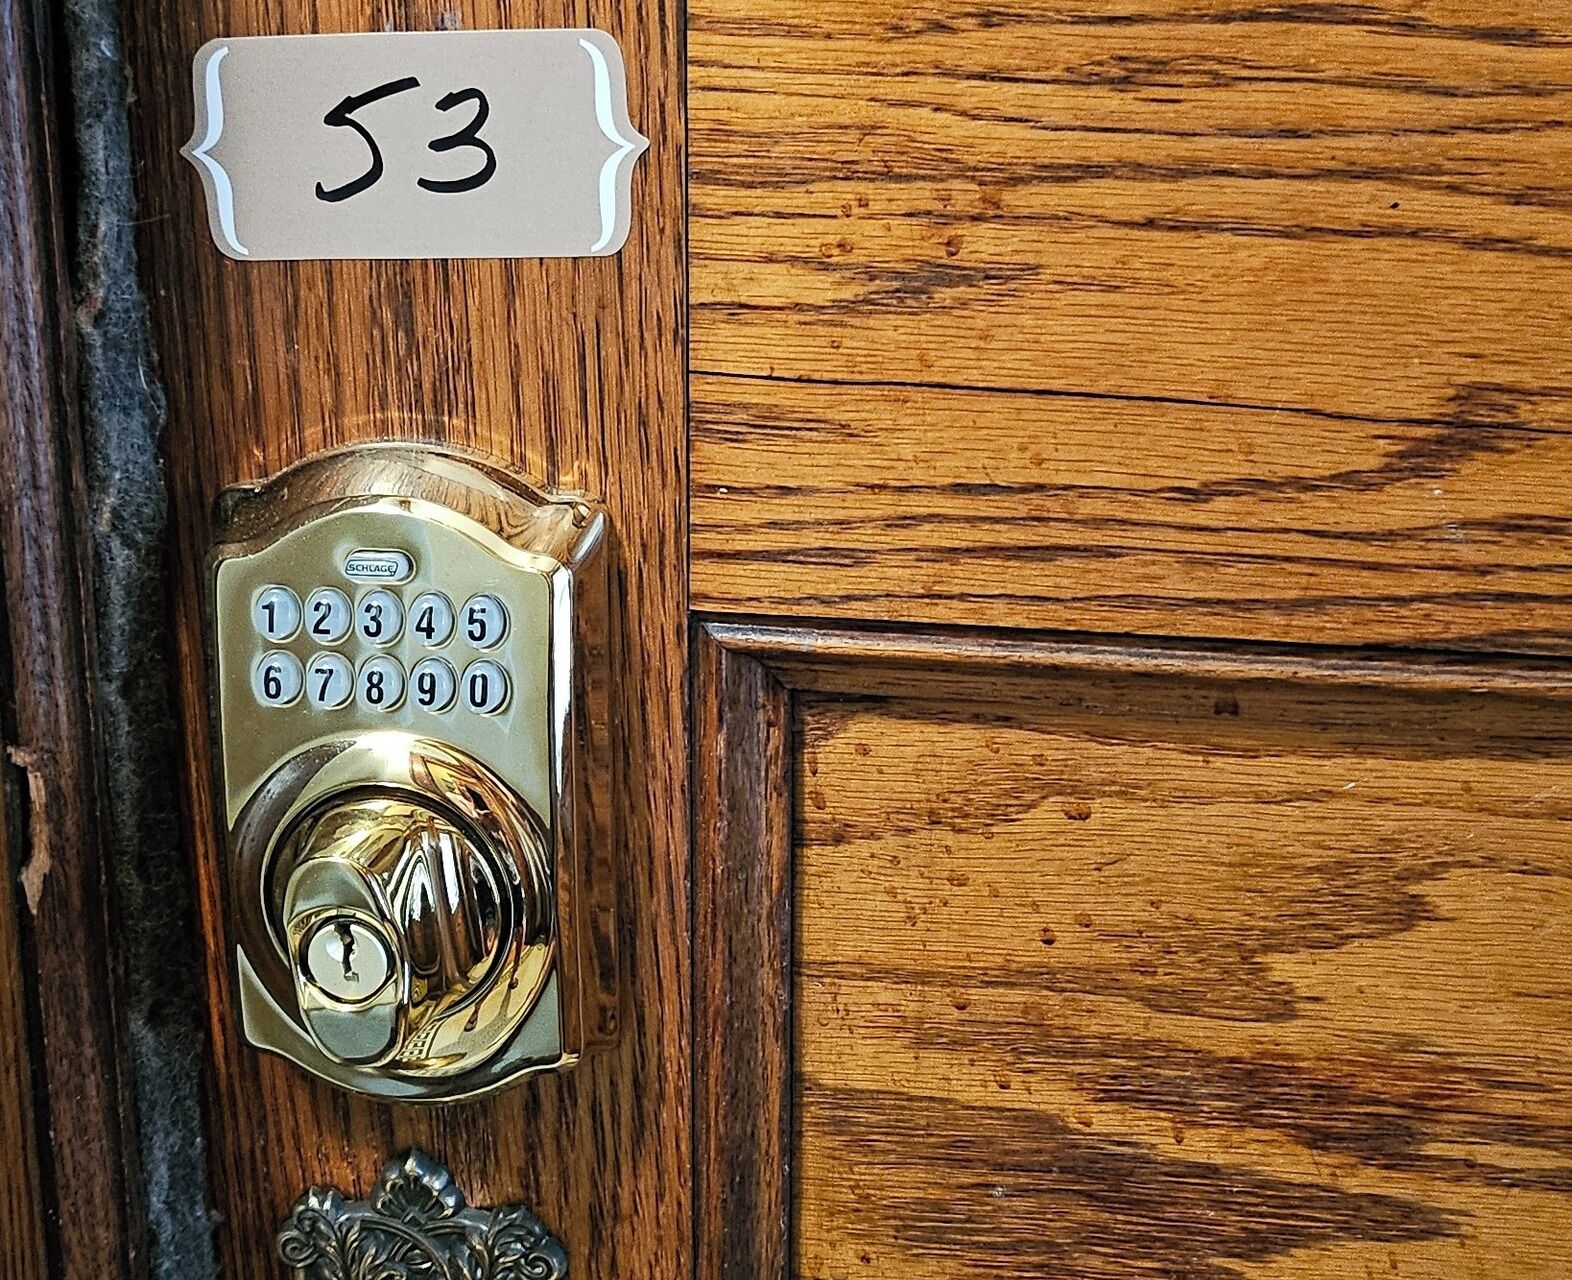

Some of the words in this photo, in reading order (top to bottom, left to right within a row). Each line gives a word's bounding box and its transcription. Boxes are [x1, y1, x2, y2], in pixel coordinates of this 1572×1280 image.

[315, 76, 497, 203] 53
[348, 563, 395, 574] SCHLAGE
[261, 600, 275, 633] 1
[312, 601, 331, 635] 2
[363, 603, 383, 638] 3
[415, 606, 435, 640] 4
[467, 607, 487, 642] 5
[263, 665, 282, 700] 6
[314, 668, 334, 702] 7
[366, 670, 384, 705] 8
[417, 672, 436, 706] 9
[469, 673, 488, 708] 0
